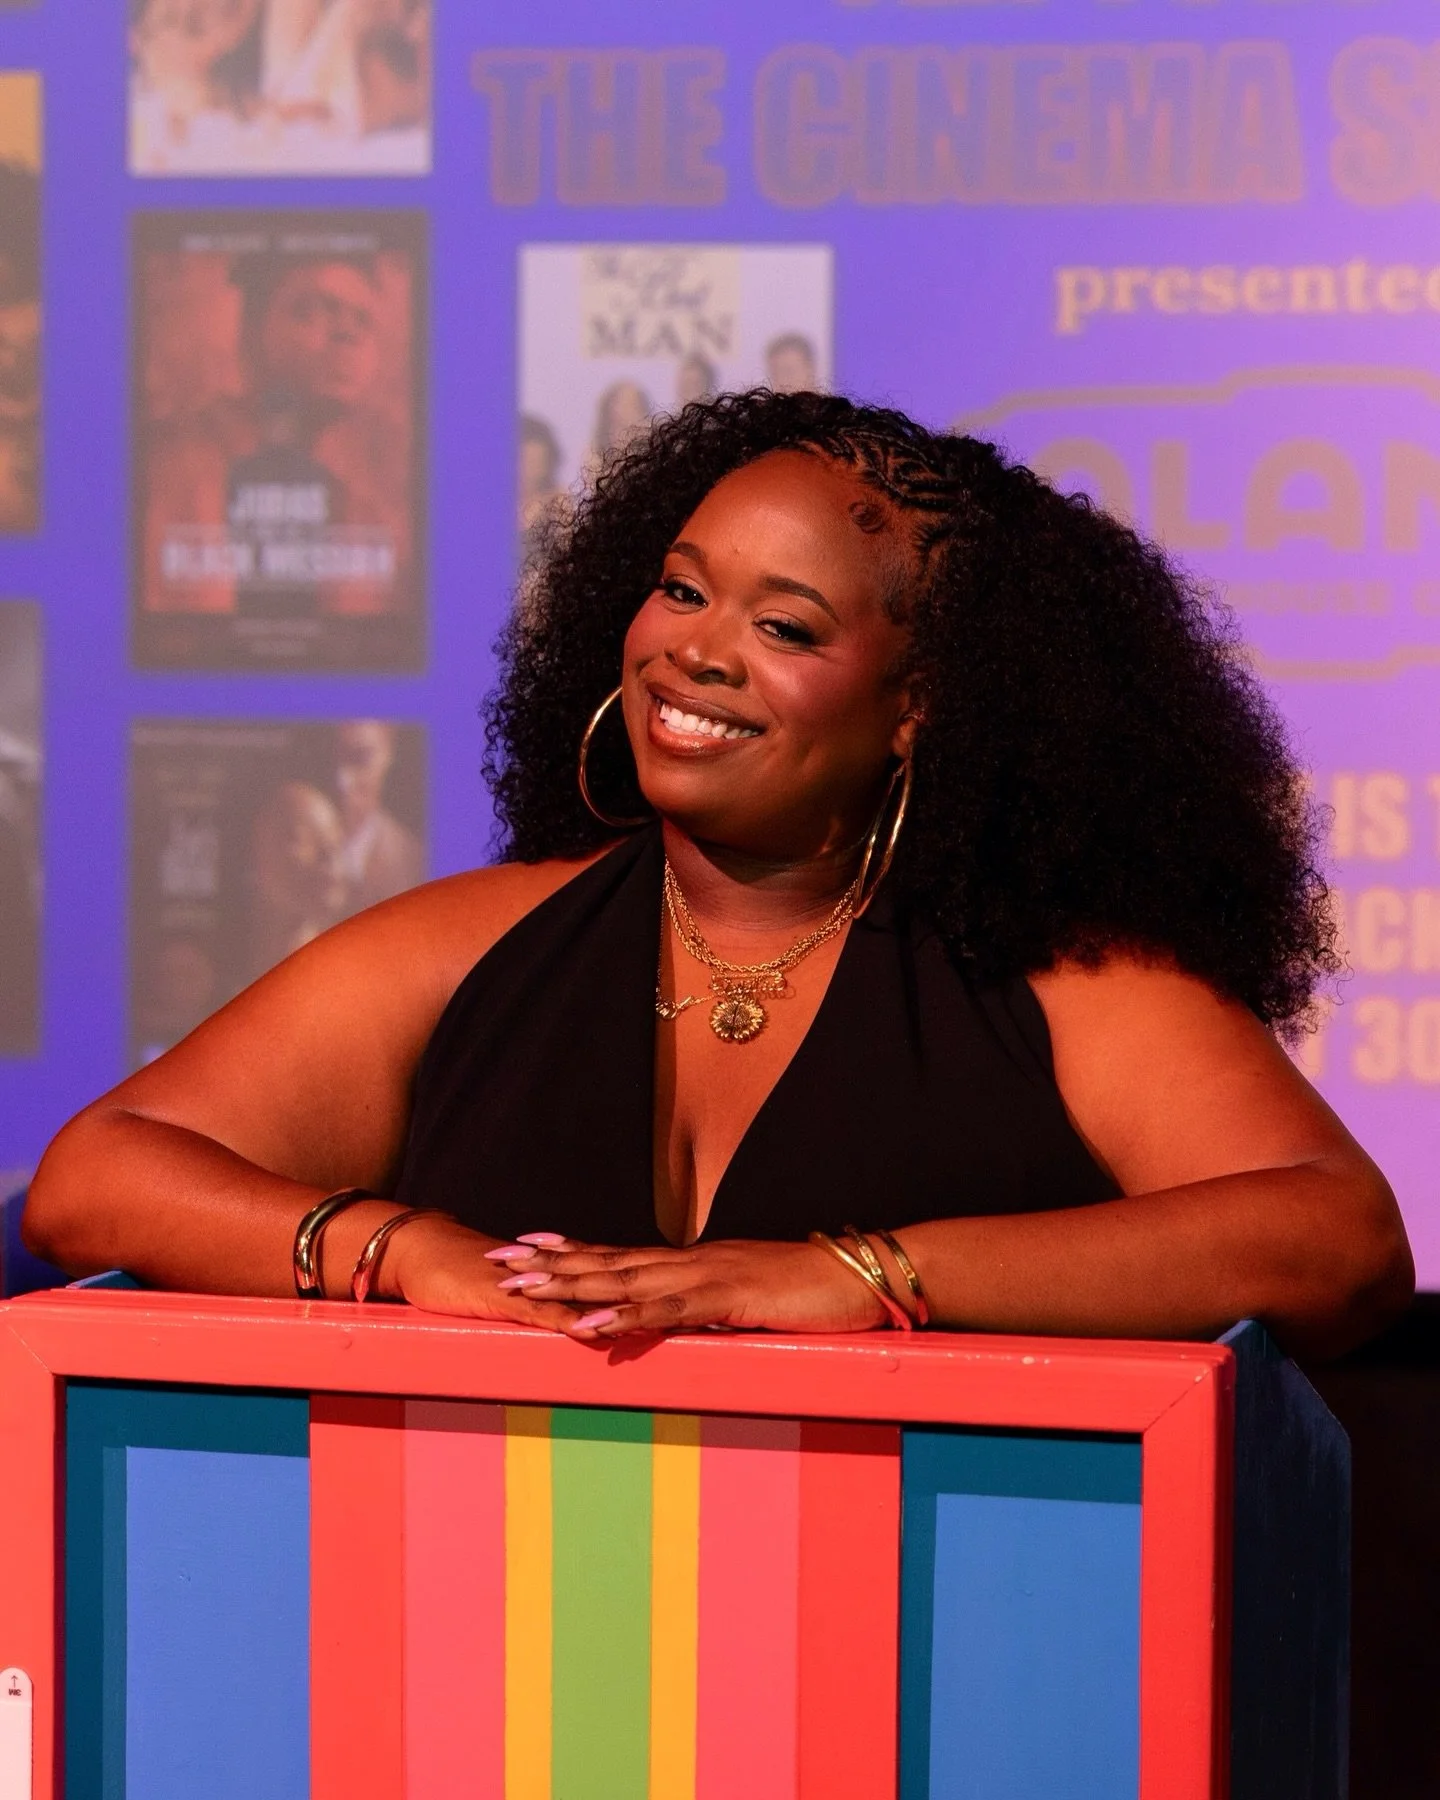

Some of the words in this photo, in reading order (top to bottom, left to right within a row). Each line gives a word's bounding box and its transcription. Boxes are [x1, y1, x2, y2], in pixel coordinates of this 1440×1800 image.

[471, 46, 727, 207] THE
[754, 40, 1304, 208] CINEMA
[1329, 34, 1440, 206] S
